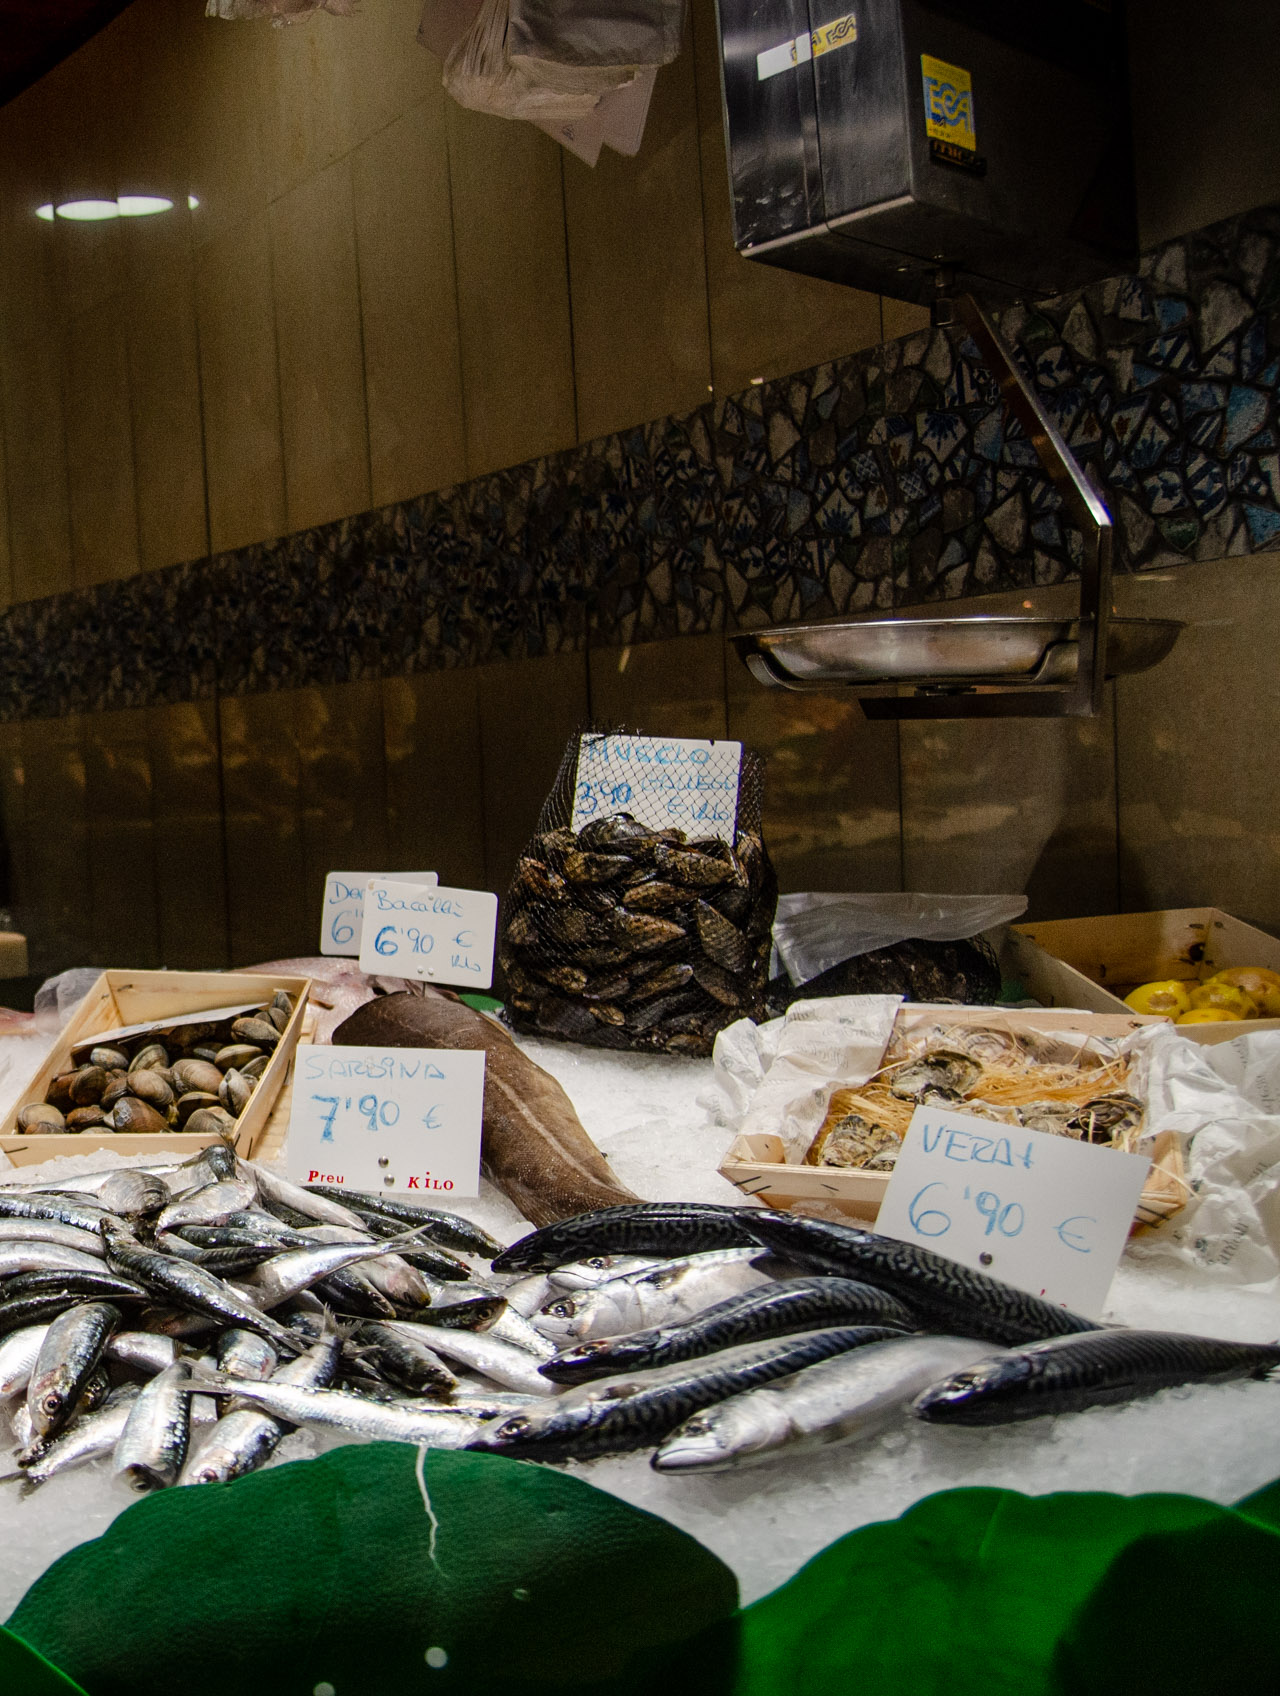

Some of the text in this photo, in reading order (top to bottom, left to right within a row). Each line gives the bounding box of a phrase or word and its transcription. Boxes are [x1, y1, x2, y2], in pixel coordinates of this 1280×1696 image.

[331, 908, 364, 944] 6'
[374, 926, 435, 956] 6'90
[311, 1094, 445, 1143] 7'90 €
[308, 1170, 344, 1184] Preu
[908, 1182, 1097, 1253] 6'90 €
